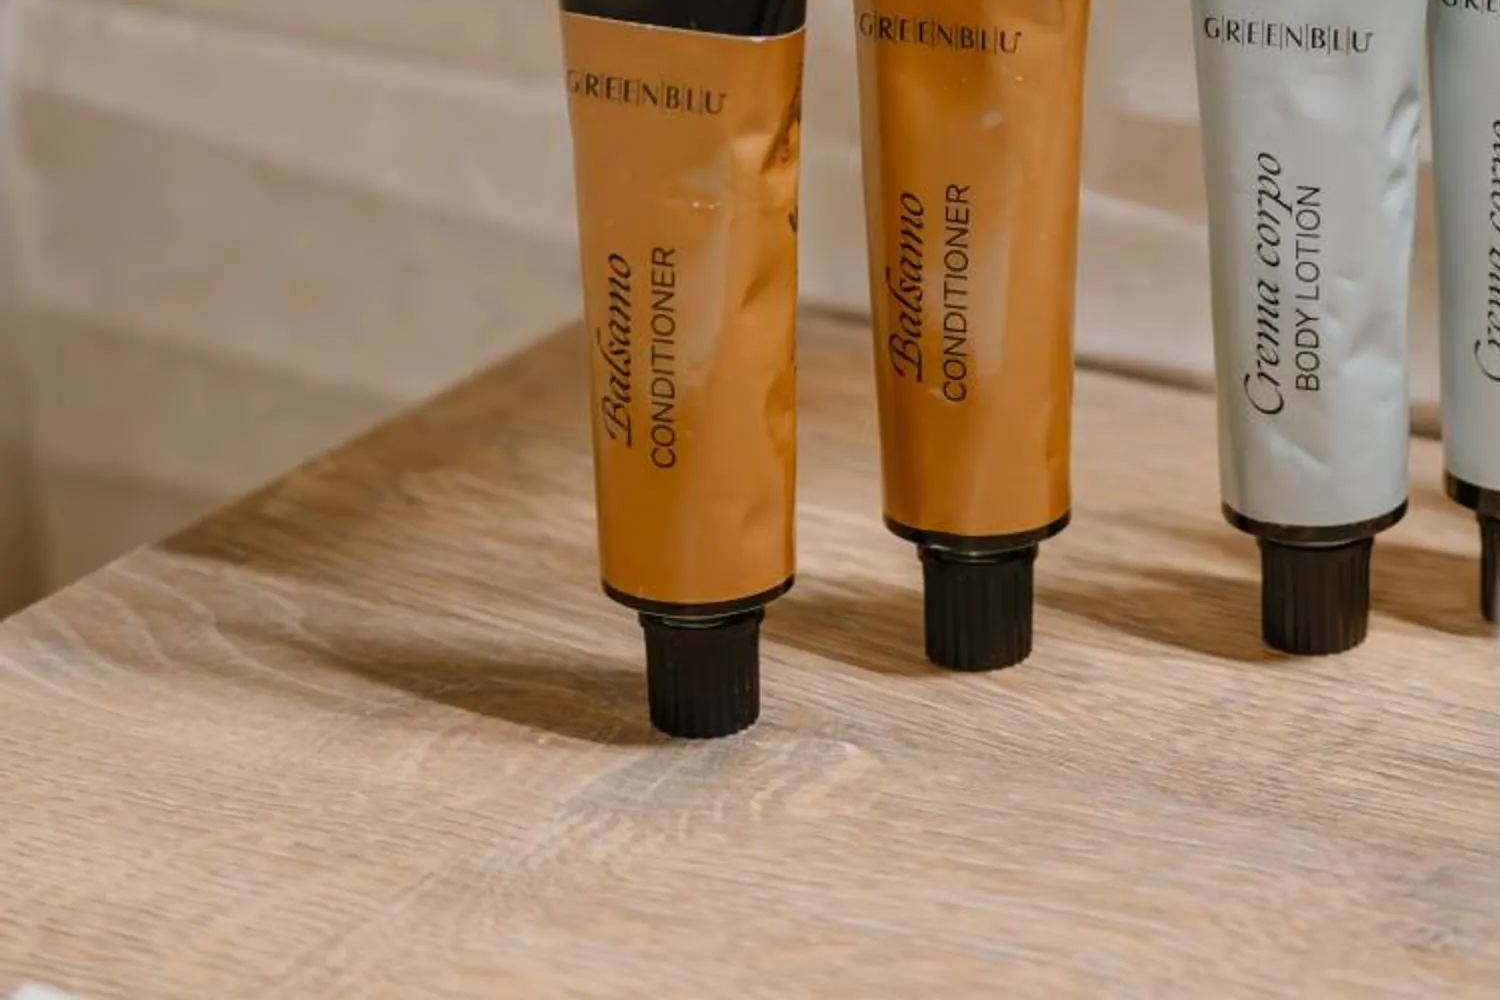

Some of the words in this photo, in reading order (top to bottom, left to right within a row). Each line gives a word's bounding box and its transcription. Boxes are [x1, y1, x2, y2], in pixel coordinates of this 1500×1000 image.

[1203, 15, 1375, 56] GREENBLU
[1256, 152, 1293, 267] corpo
[1295, 185, 1321, 301] LOTION
[597, 252, 632, 448] Balsamo
[885, 191, 925, 382] Balsamo
[942, 183, 971, 402] CONDITIONER
[1243, 278, 1284, 415] Crema
[1295, 308, 1321, 391] BODY
[650, 246, 677, 469] CONDITIONER
